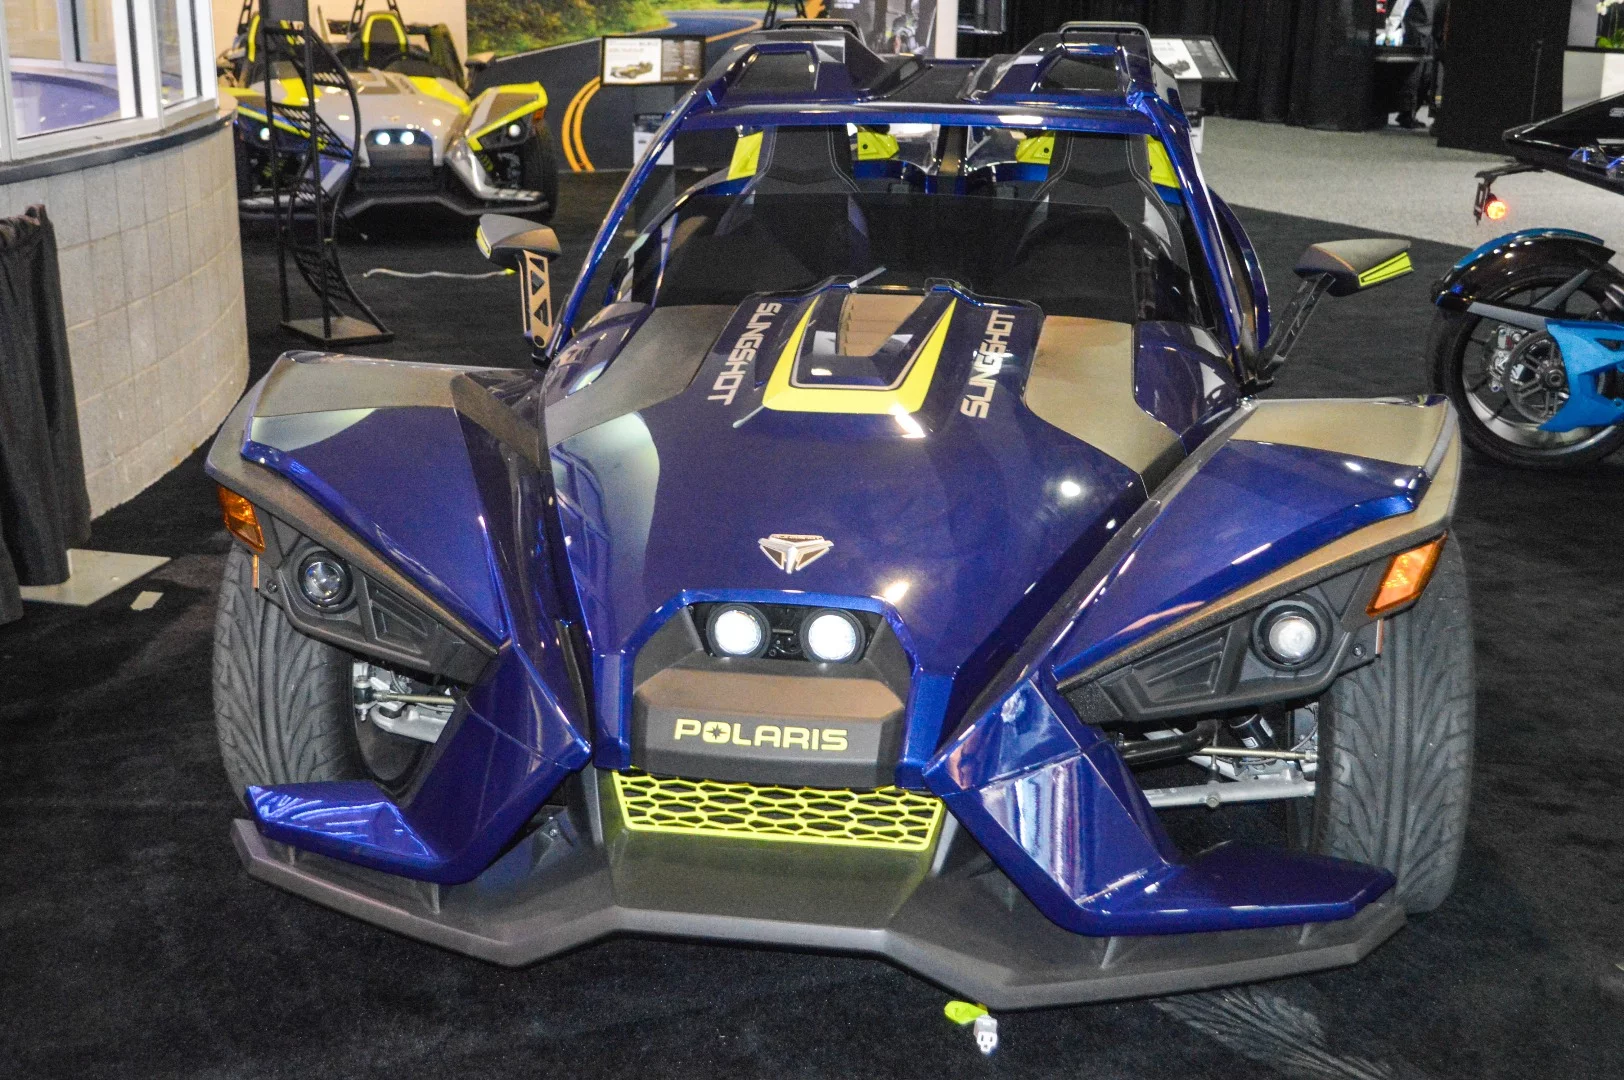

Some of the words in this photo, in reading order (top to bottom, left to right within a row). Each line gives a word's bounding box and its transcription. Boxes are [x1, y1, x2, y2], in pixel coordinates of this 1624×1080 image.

[707, 302, 782, 406] SLINGSHOT
[960, 309, 1016, 419] SLINGSHOT
[674, 718, 848, 751] POLARIS
